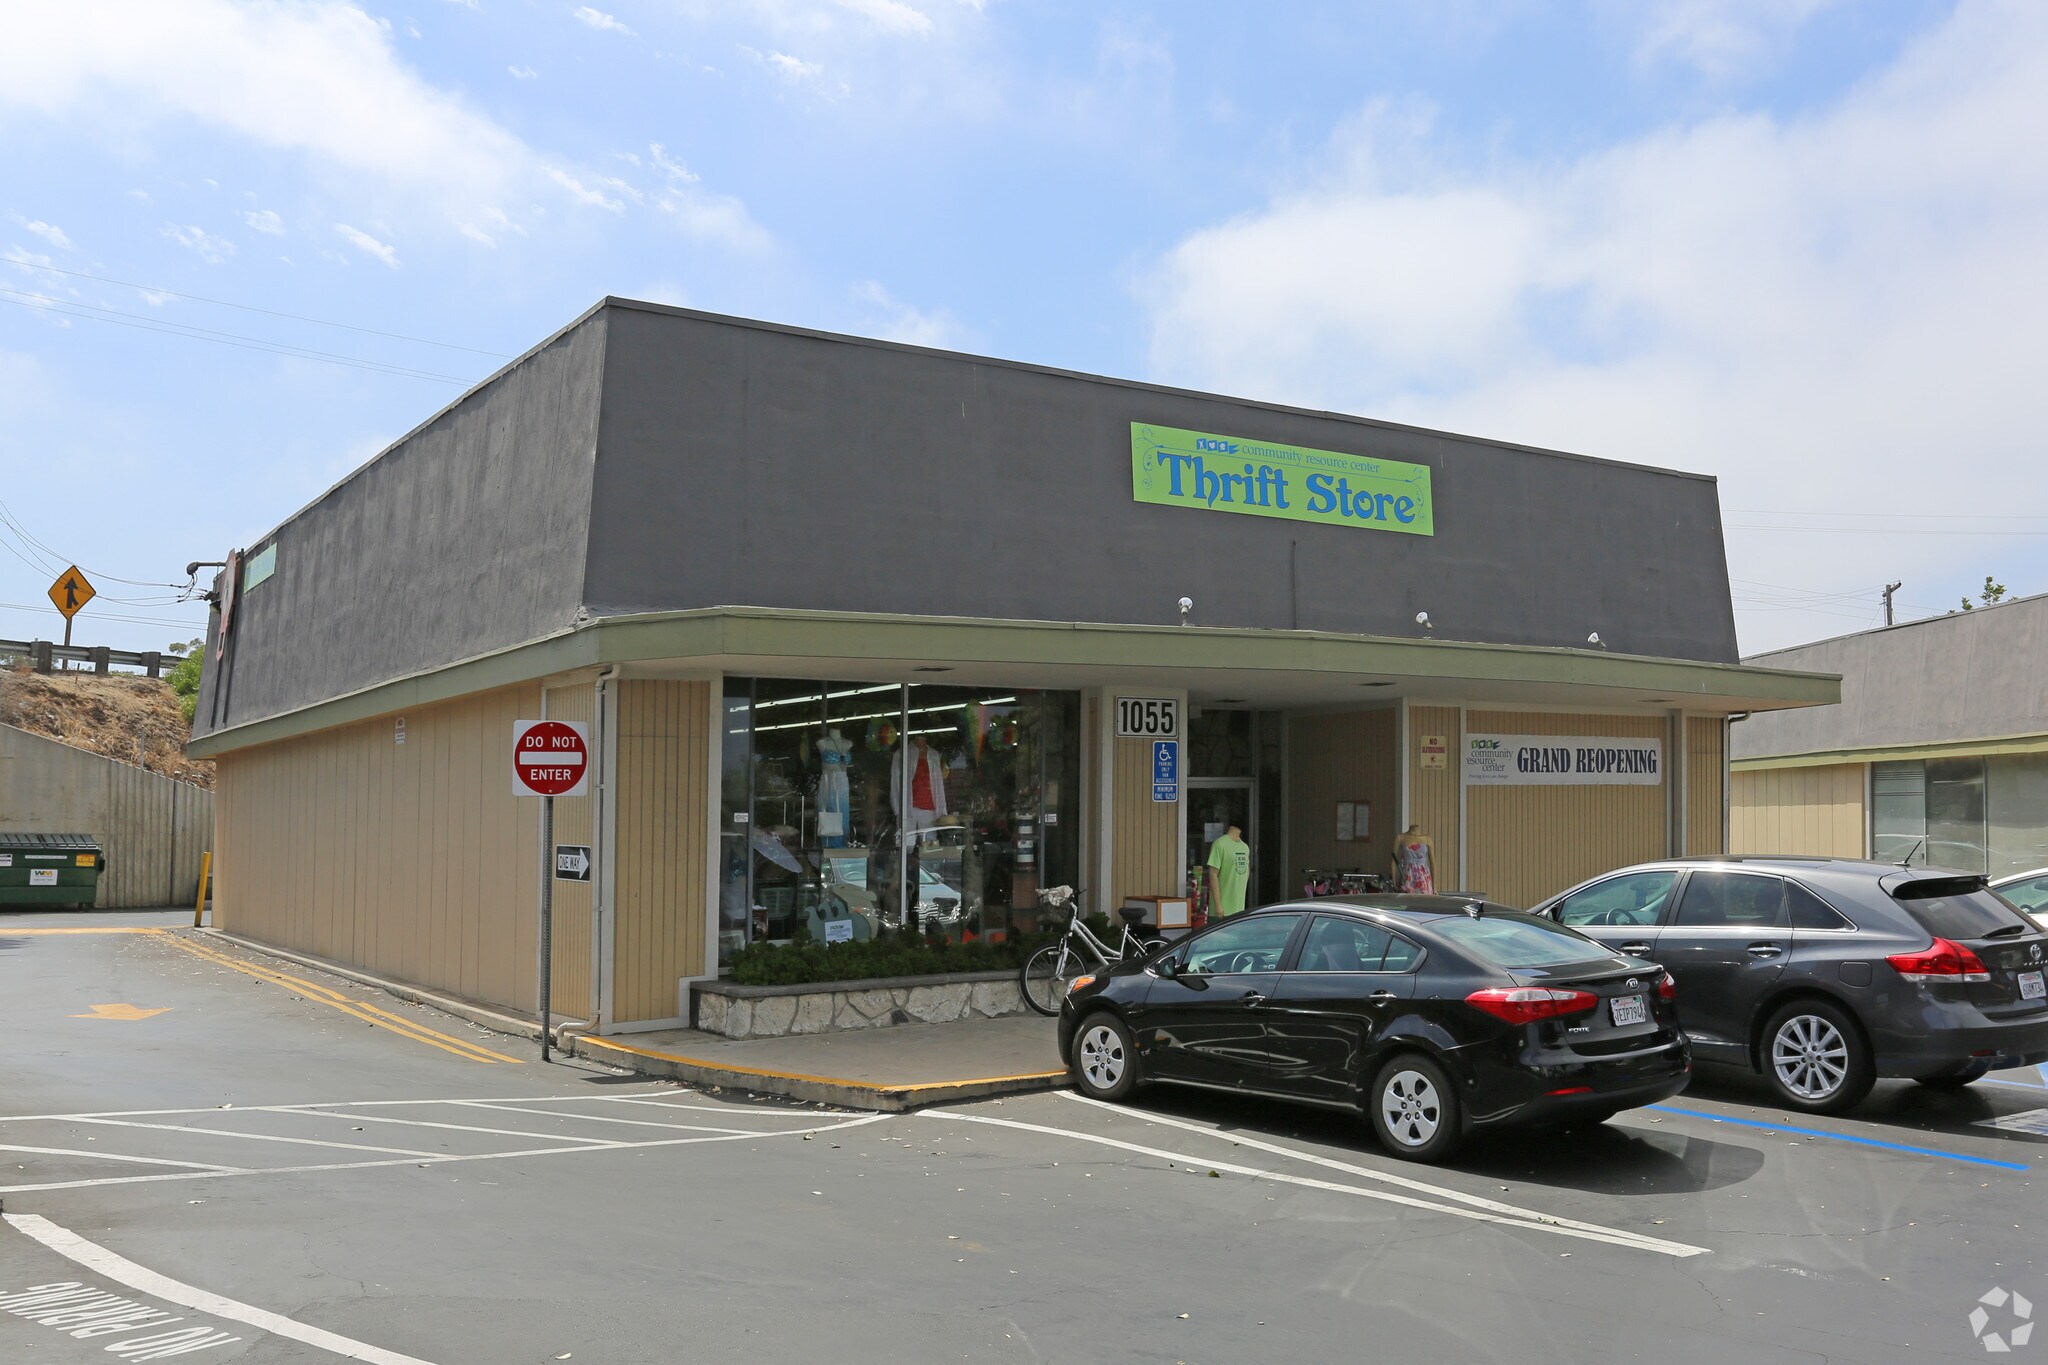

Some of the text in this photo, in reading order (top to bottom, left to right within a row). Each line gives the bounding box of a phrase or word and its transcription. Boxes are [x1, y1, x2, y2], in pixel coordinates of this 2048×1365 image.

[1242, 443, 1380, 474] community resource center
[1156, 451, 1416, 524] Thrift Store
[1120, 700, 1174, 734] 1055
[526, 736, 577, 748] DO NOT
[1429, 737, 1438, 746] NO
[1471, 748, 1514, 762] community
[1517, 747, 1657, 774] GRAND REOPENING
[530, 769, 572, 781] ENTER
[1482, 763, 1505, 772] center
[558, 855, 580, 870] ONE WAY
[104, 1326, 242, 1363] NO
